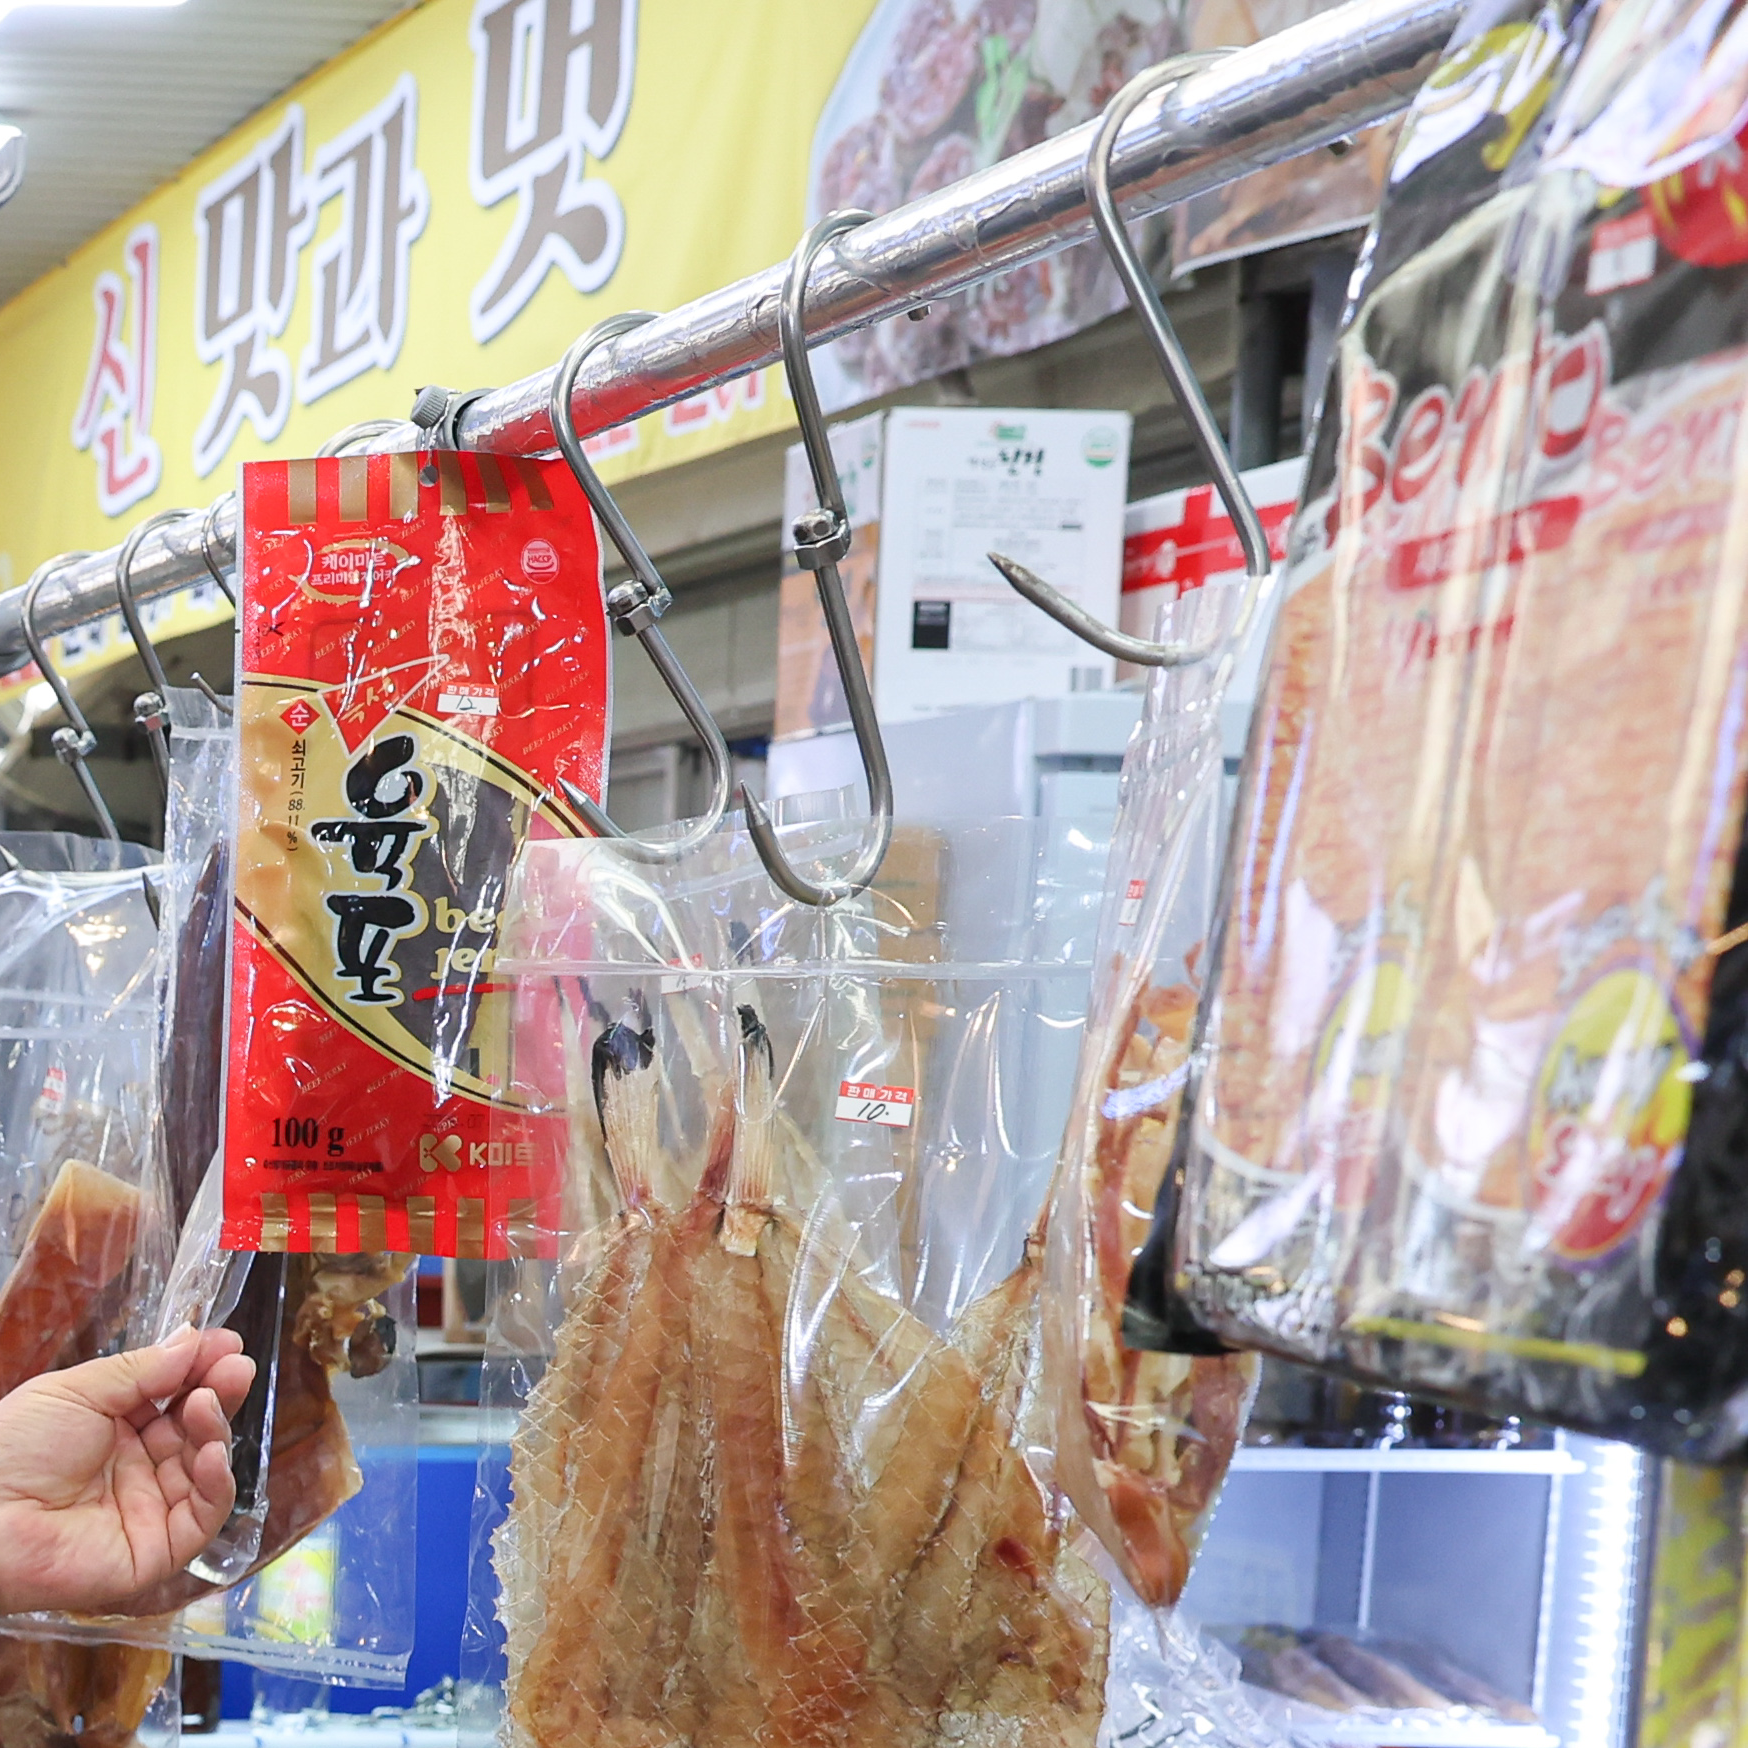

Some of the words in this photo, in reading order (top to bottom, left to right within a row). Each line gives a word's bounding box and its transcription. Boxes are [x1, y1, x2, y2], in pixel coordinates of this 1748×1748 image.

[195, 75, 431, 476] 맛과
[471, 0, 636, 344] 멋
[446, 684, 496, 698] 판매가격
[289, 705, 311, 728] 순
[311, 734, 429, 1005] 육포
[272, 1117, 319, 1149] 100
[327, 1126, 345, 1157] g
